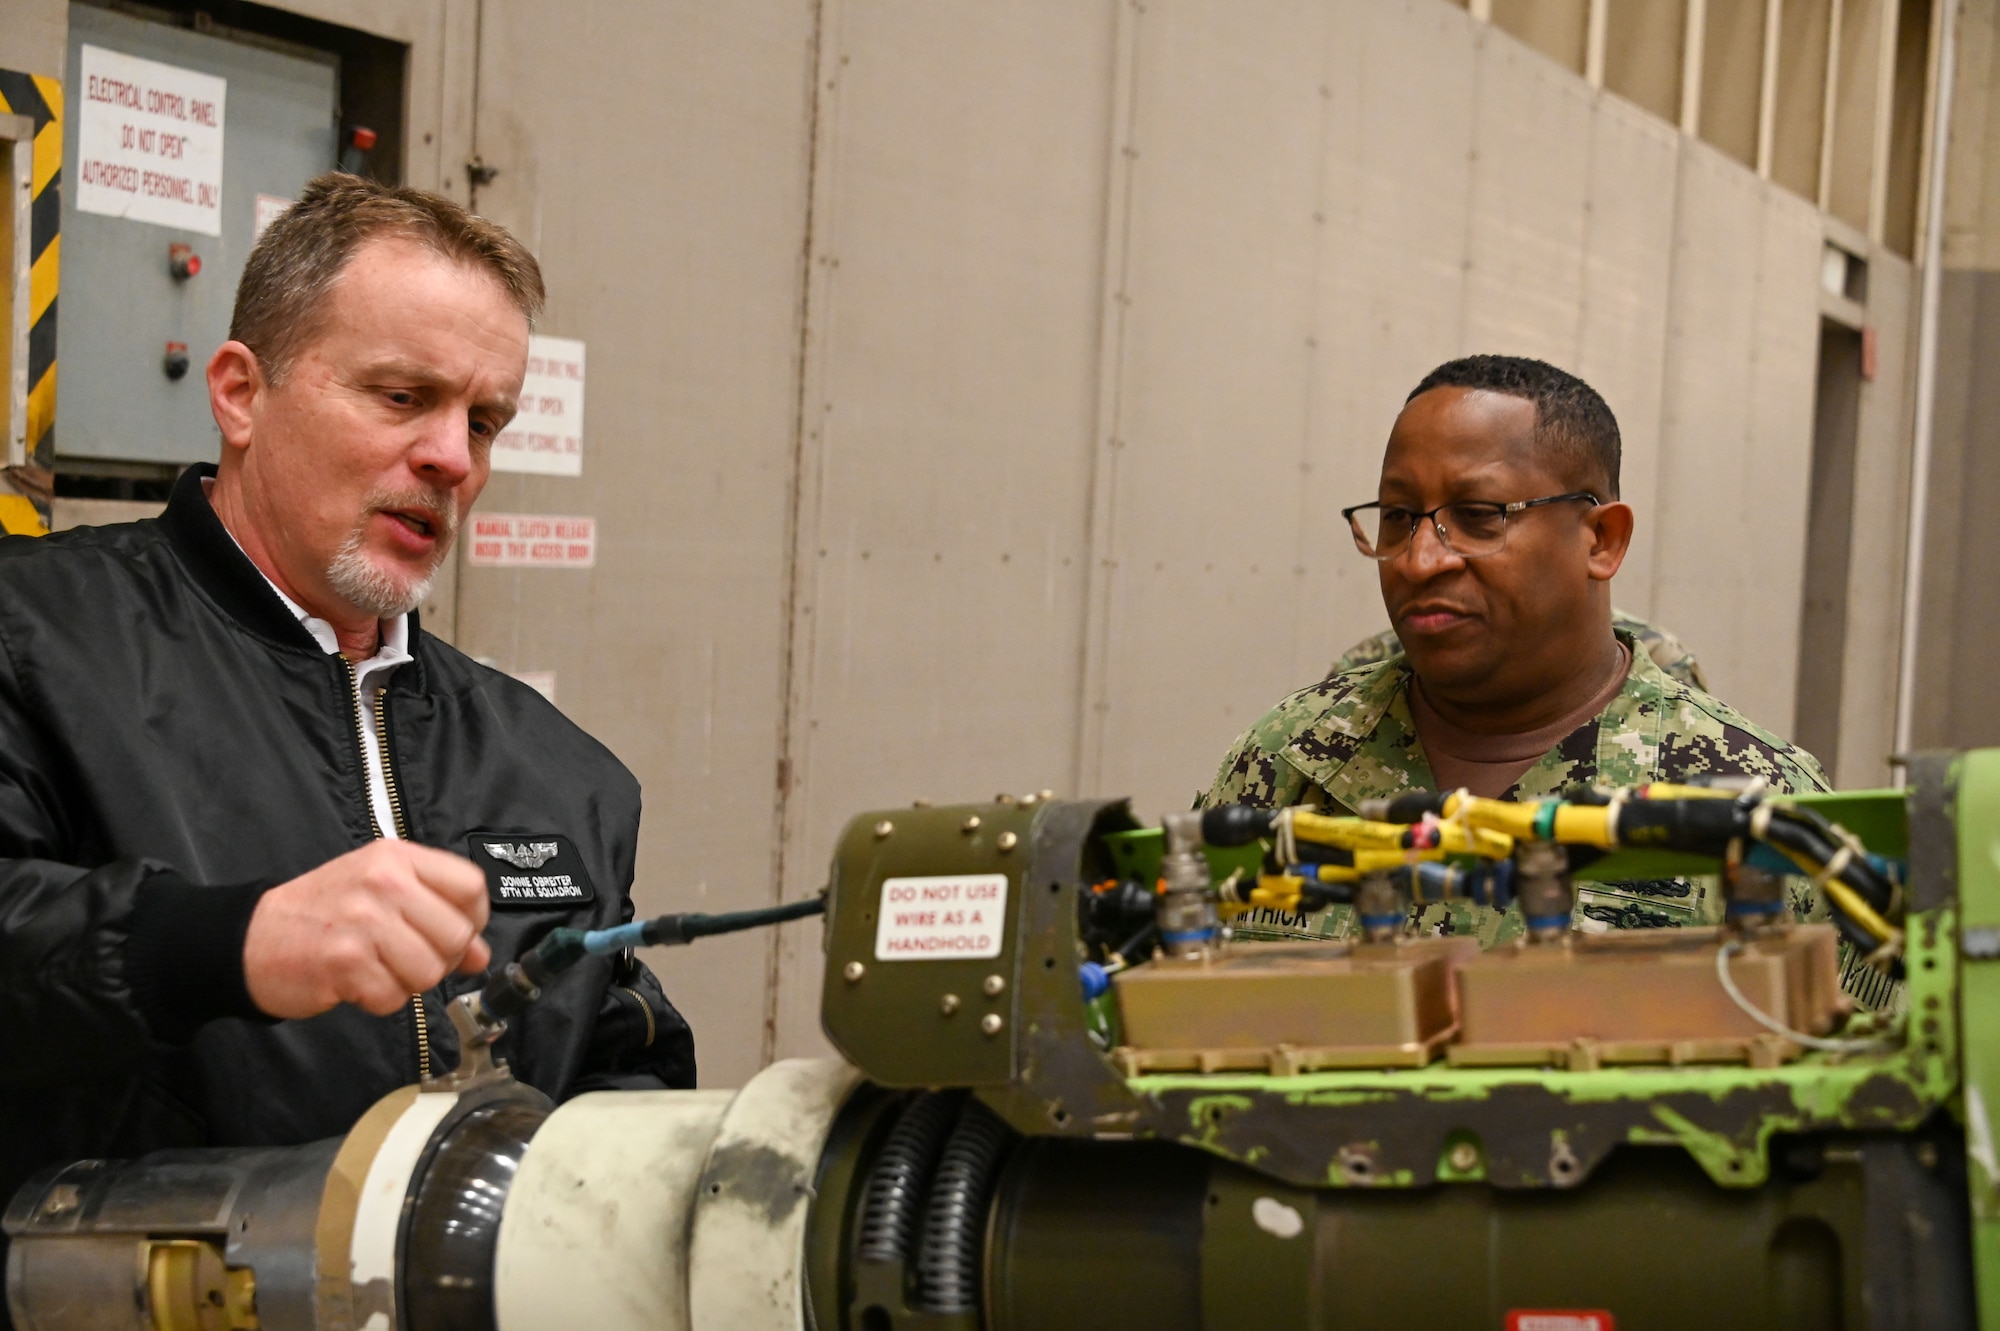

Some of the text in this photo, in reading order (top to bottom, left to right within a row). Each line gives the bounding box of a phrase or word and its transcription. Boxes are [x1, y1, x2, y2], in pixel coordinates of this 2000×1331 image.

[89, 75, 217, 127] ELECTRICAL CONTROL PANEL
[122, 124, 184, 160] DO NOT OPEN
[82, 159, 219, 209] AUTHORIZED PERSONNEL ONLY
[476, 521, 511, 537] MANUAL
[518, 521, 551, 538] CLUTCH
[531, 543, 563, 559] ACCESS
[501, 875, 571, 887] DONNIE OBREITER
[500, 886, 583, 898] 97TH MX SQUADRON
[889, 883, 998, 902] DO NOT USE
[895, 910, 983, 927] WIRE AS A
[888, 936, 990, 950] HANDHOLD
